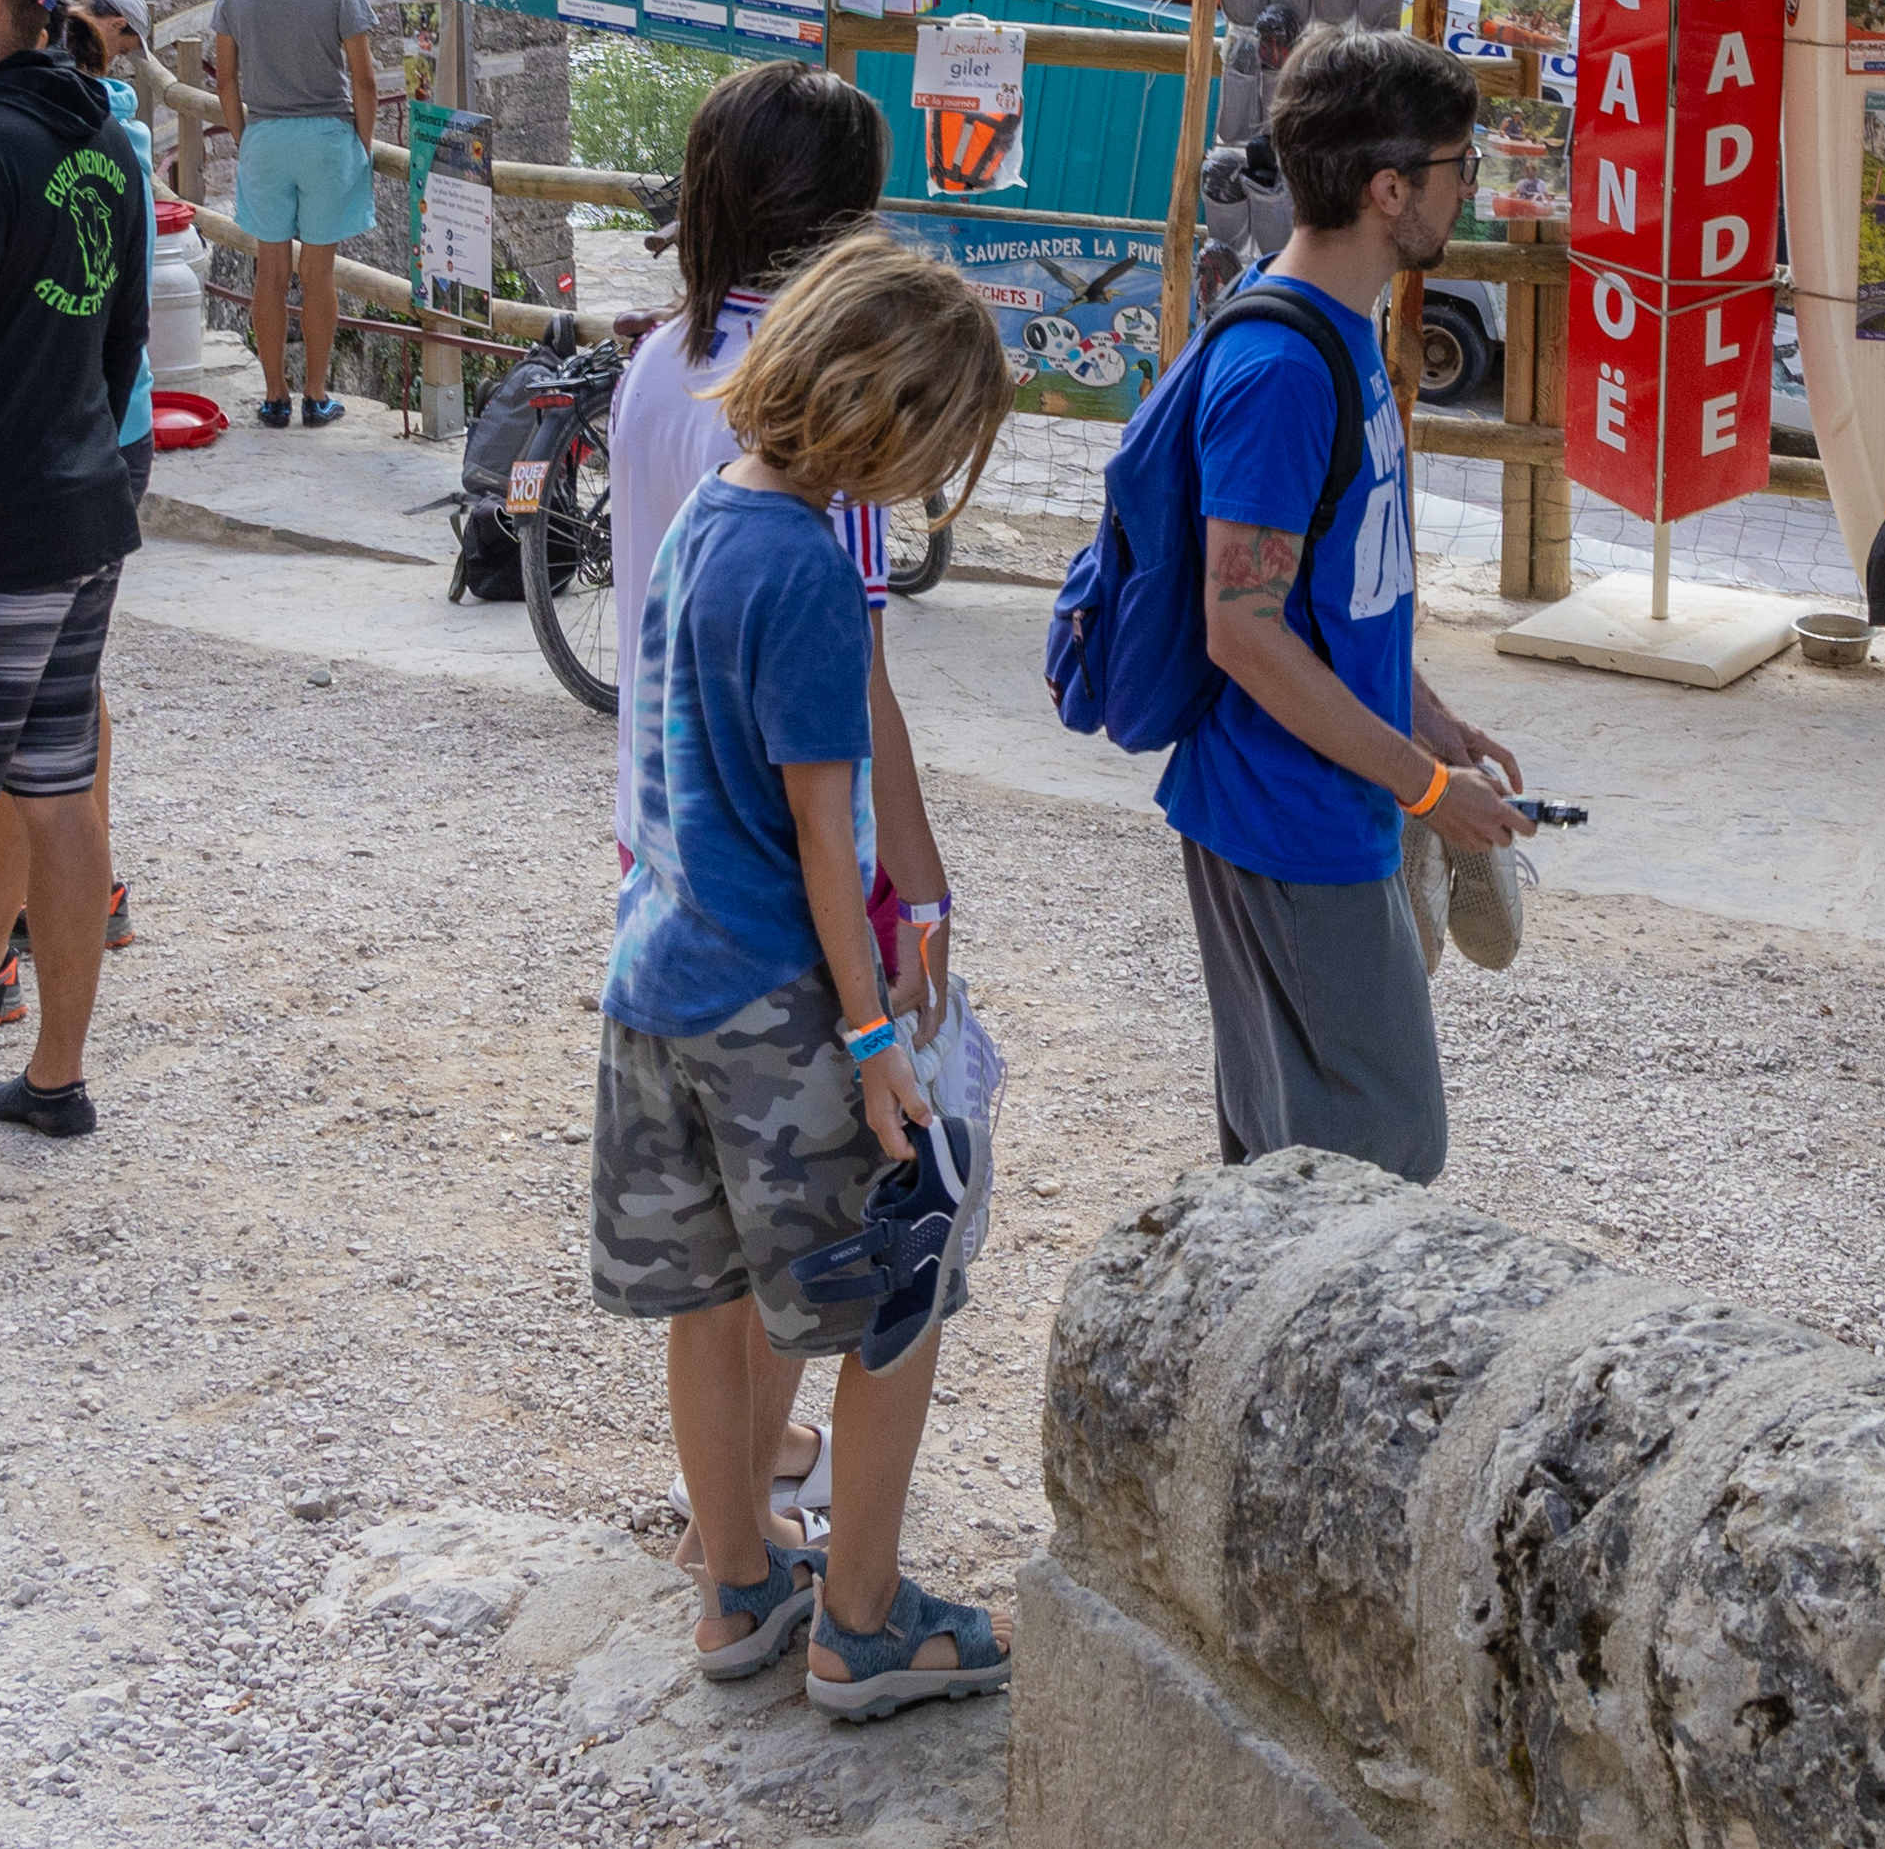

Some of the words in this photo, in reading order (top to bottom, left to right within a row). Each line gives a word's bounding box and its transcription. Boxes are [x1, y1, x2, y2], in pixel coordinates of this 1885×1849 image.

[940, 33, 1005, 56] Location
[951, 57, 991, 79] gilet
[943, 96, 977, 108] journée
[44, 156, 81, 209] EVEIL
[74, 149, 127, 195] MENDOIS
[942, 243, 955, 264] À
[966, 237, 1084, 264] SAUVEGARDER
[1093, 238, 1116, 258] LA
[1127, 239, 1165, 265] RIVIÈ
[510, 462, 547, 482] LOUEZ
[510, 478, 541, 503] MOI
[830, 1243, 863, 1263] GEOX
